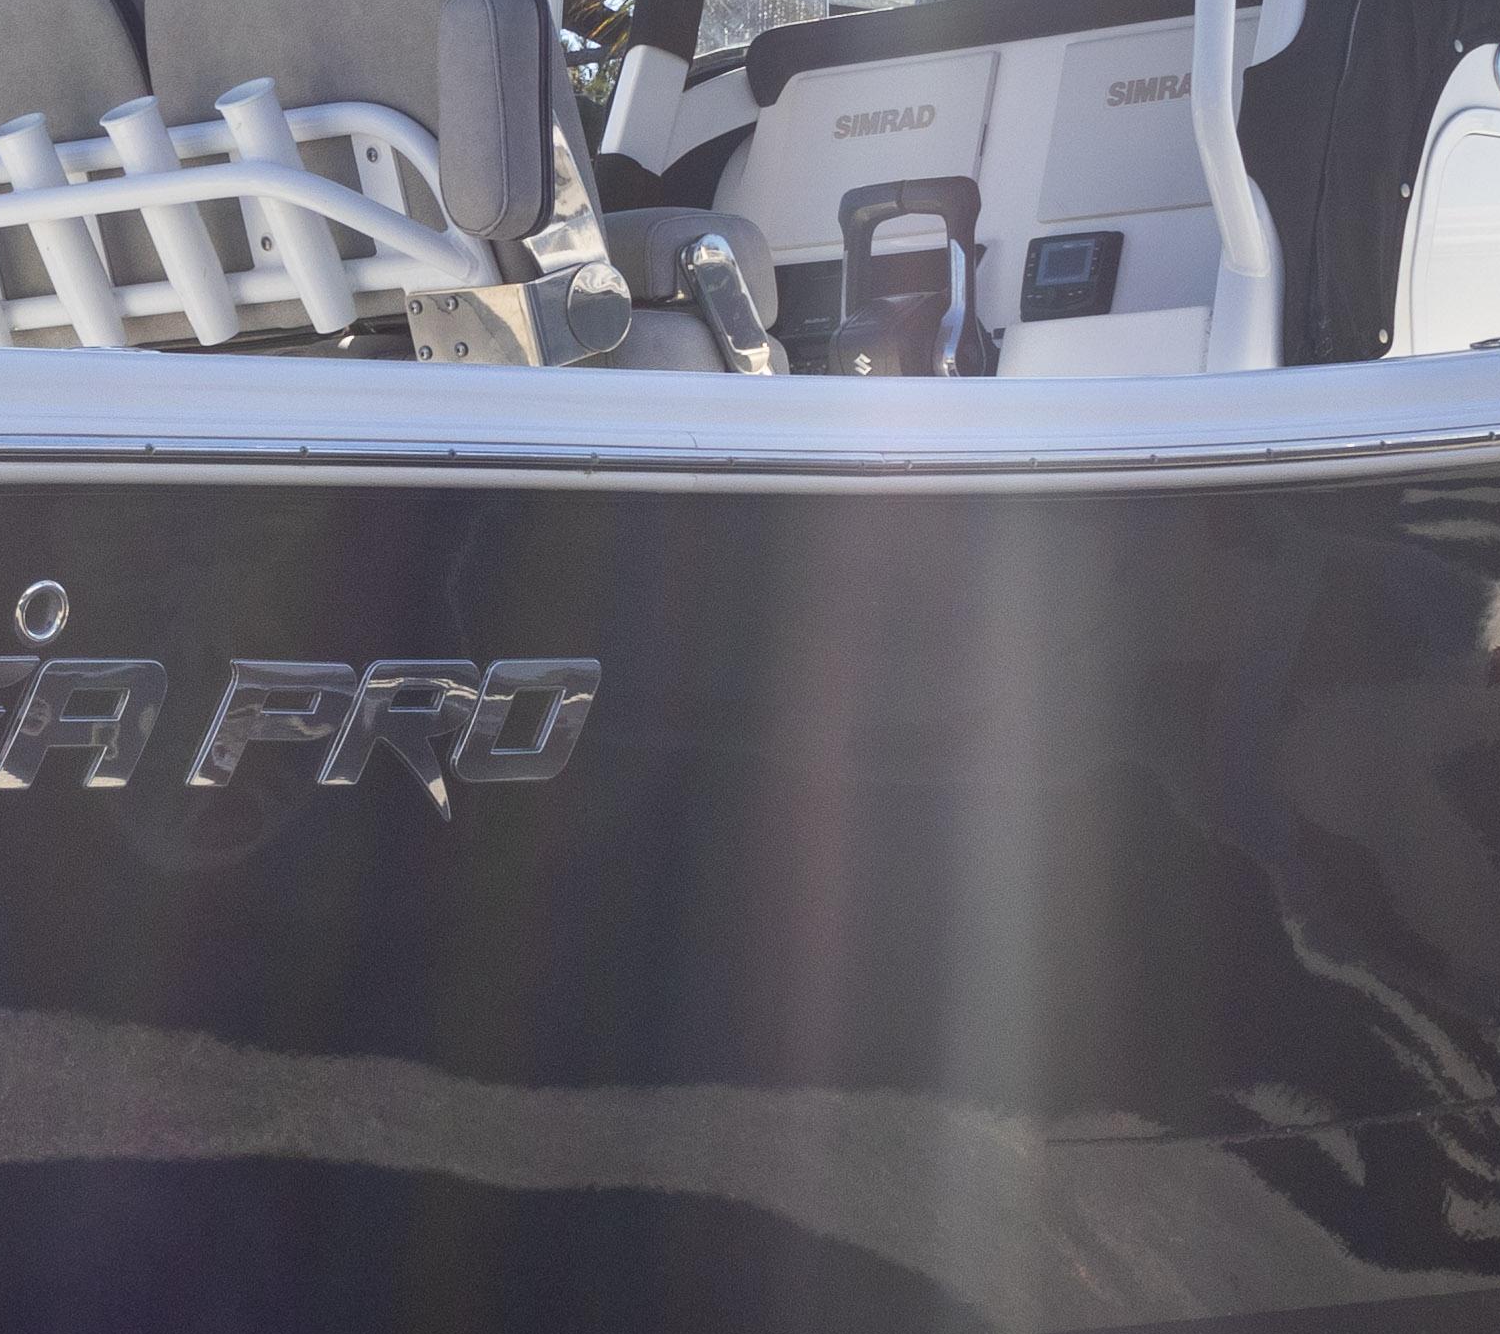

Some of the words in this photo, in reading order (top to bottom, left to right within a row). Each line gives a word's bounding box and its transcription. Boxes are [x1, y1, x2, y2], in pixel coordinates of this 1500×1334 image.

[1106, 72, 1192, 107] SIMRA
[833, 104, 936, 141] SIMRAD
[186, 657, 602, 822] PRO
